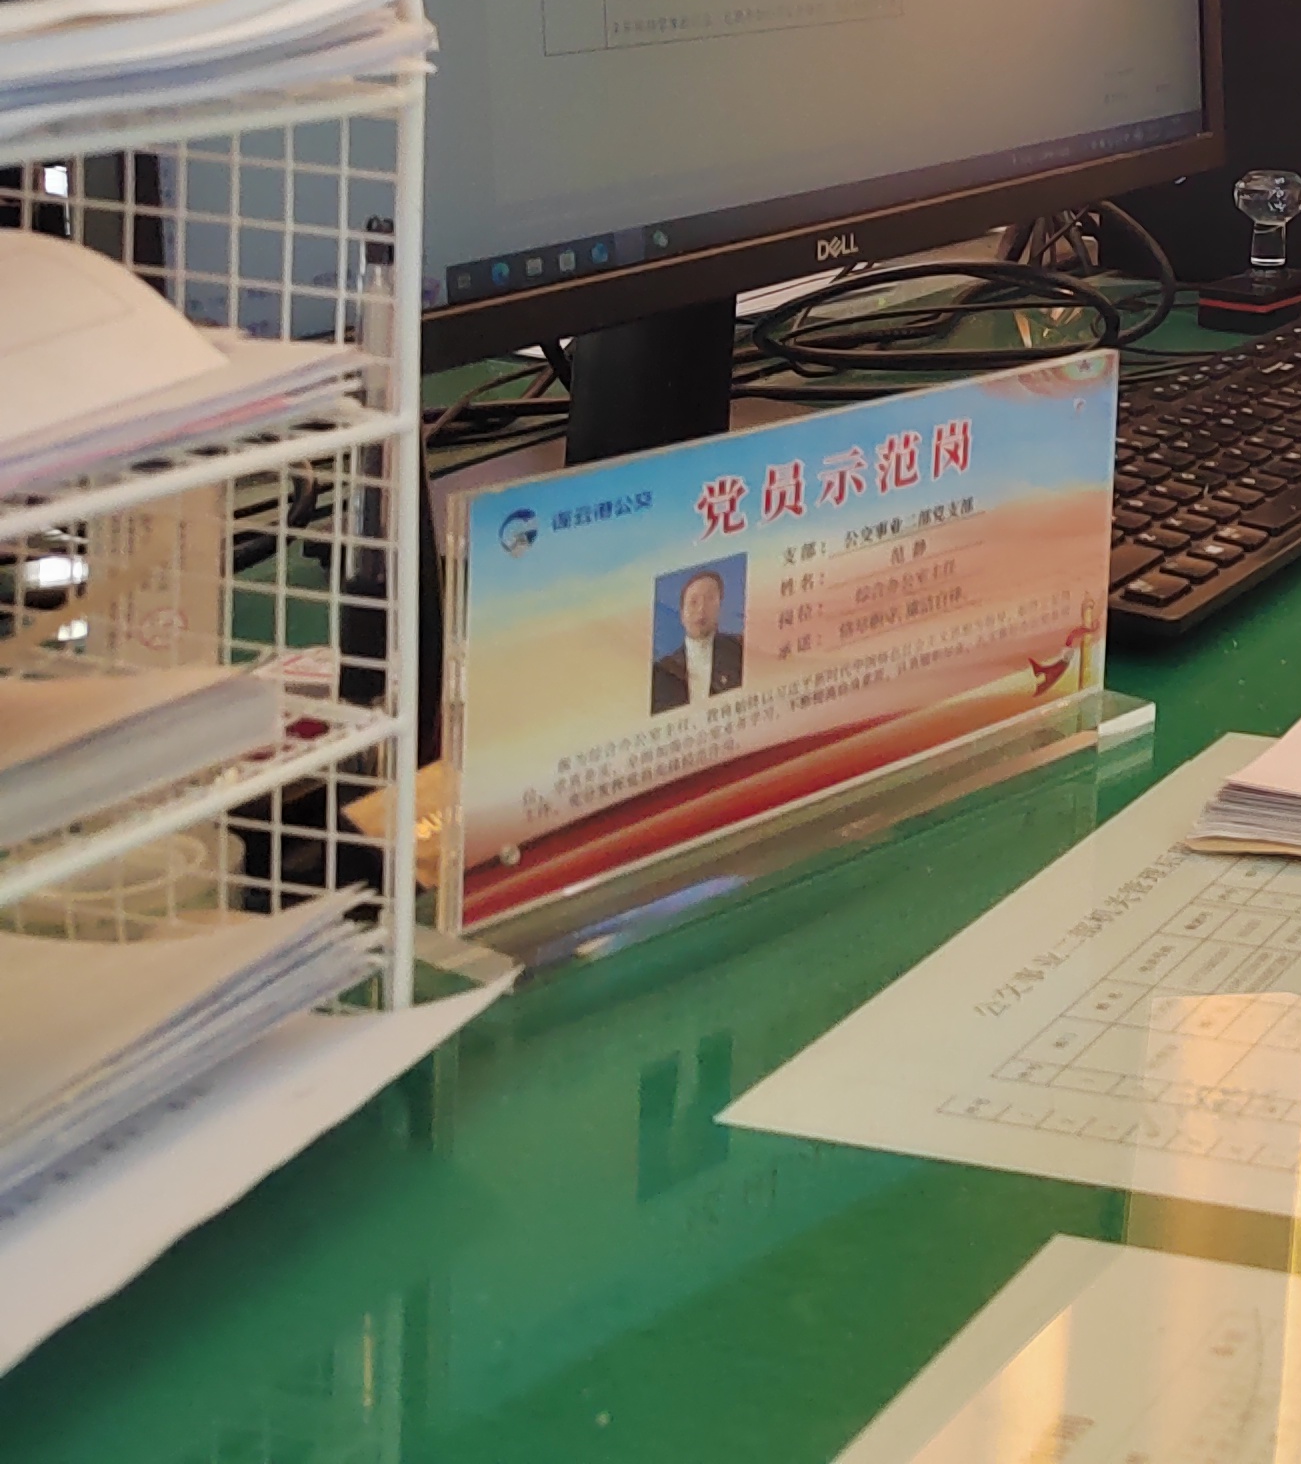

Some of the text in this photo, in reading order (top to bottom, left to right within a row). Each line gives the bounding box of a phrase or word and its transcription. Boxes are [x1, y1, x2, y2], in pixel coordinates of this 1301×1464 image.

[817, 232, 859, 261] DELL
[695, 417, 973, 541] 党员示范岗
[551, 491, 653, 532] 连云港公交
